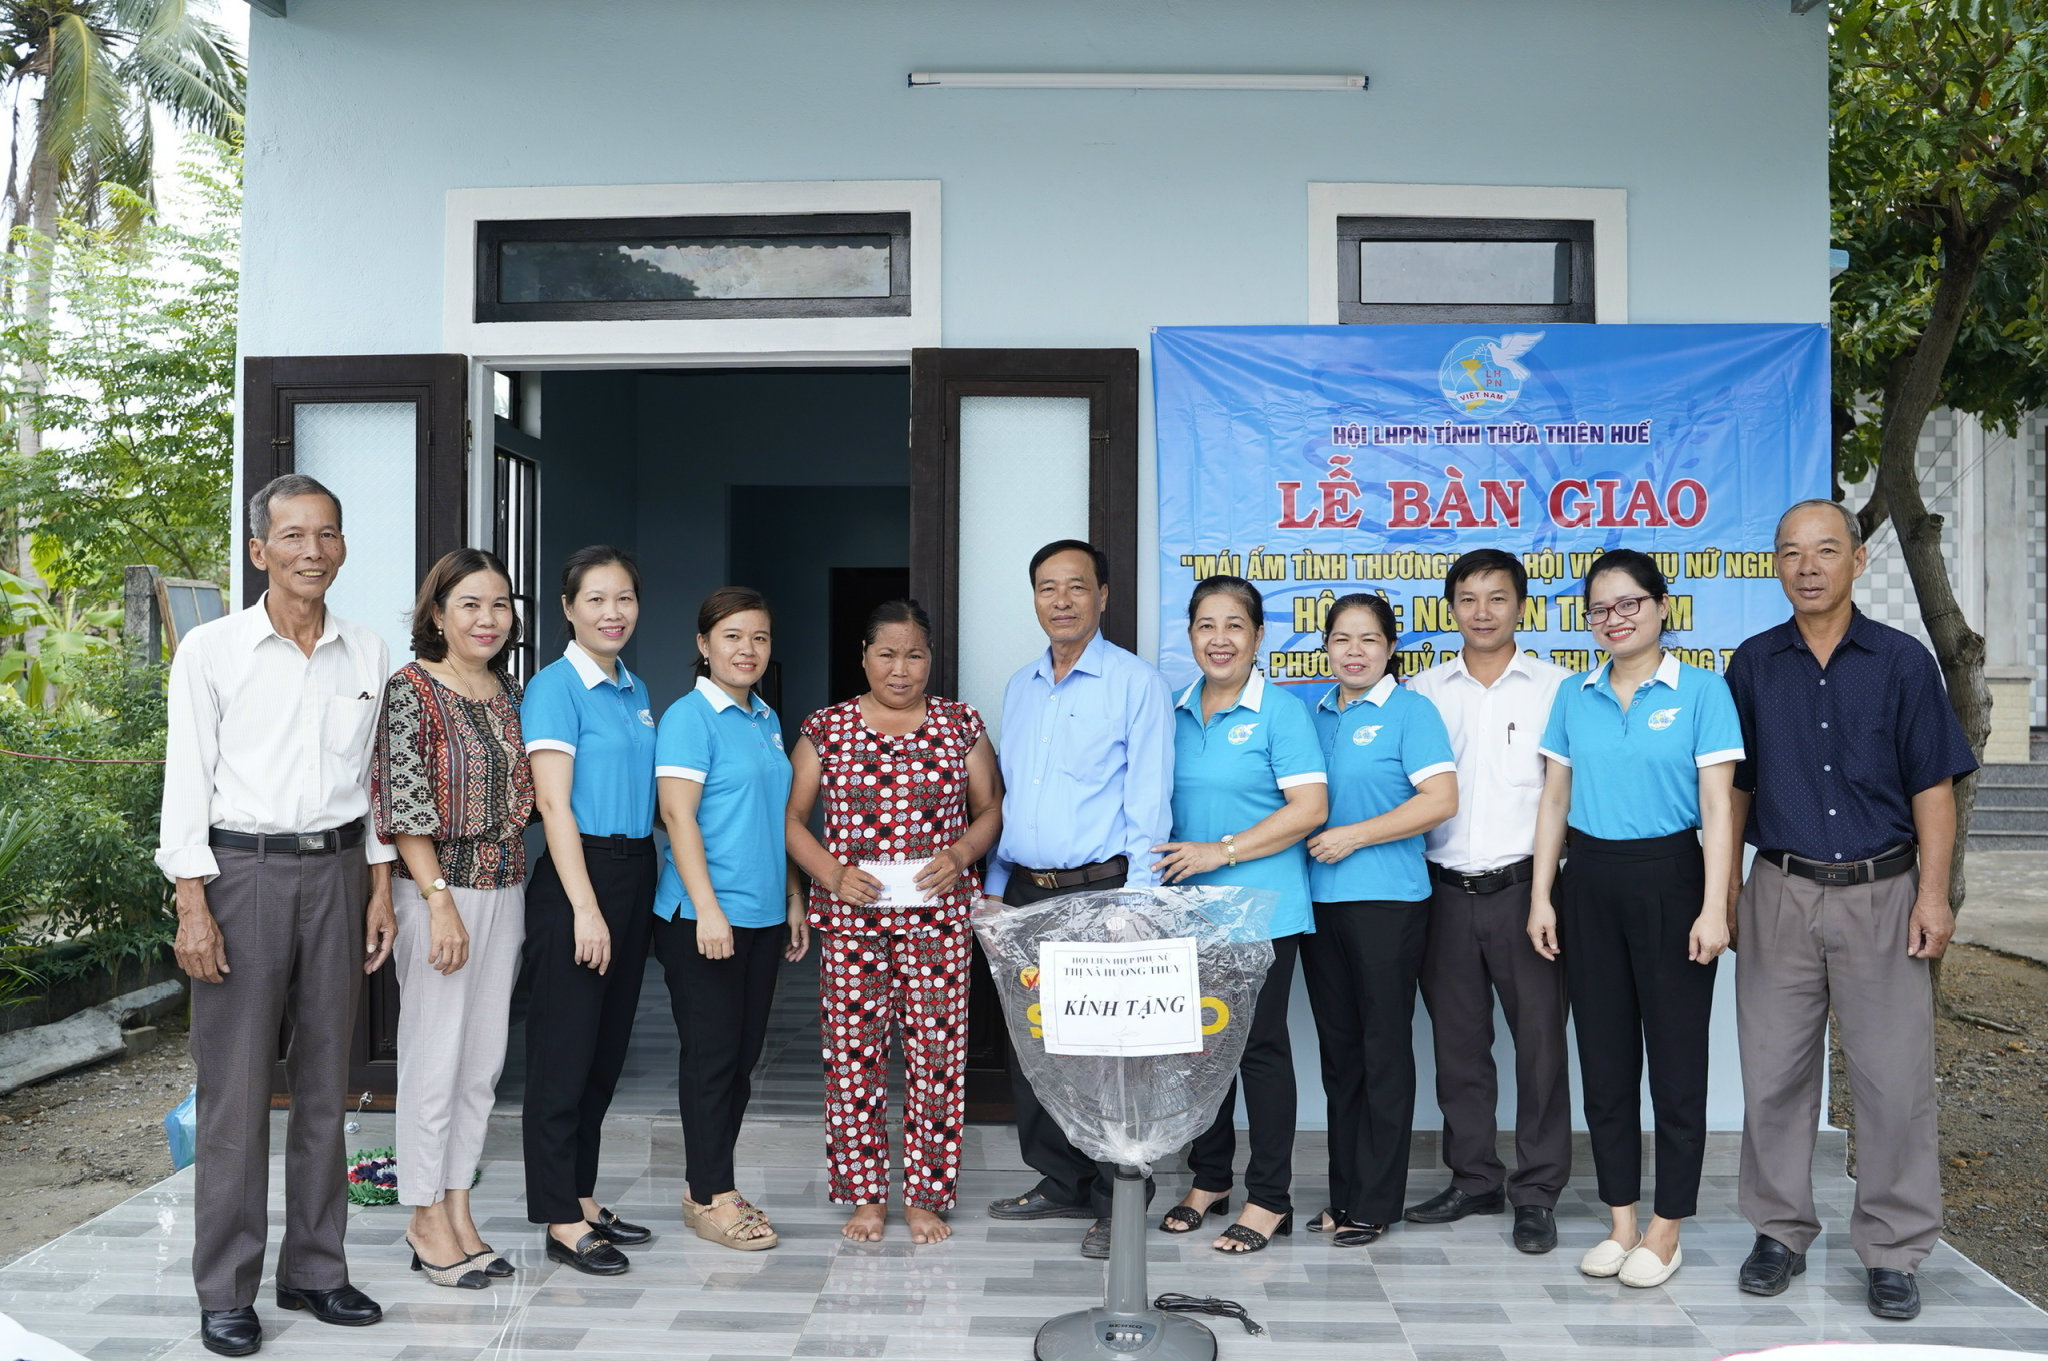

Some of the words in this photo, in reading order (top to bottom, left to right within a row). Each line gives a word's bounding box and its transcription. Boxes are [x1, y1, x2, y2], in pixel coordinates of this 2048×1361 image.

[1486, 370, 1502, 378] LH
[1486, 379, 1503, 388] PN
[1483, 392, 1503, 401] NAM
[1333, 423, 1368, 448] HỘI
[1373, 426, 1428, 444] LHPN
[1433, 420, 1481, 443] TỈNH
[1487, 422, 1540, 443] THỪA
[1545, 422, 1605, 443] THIÊN
[1610, 420, 1652, 443] HUẾ
[1277, 455, 1364, 528] LỄ
[1387, 466, 1525, 528] BÀN
[1549, 478, 1708, 528] GIAO
[1247, 546, 1285, 580] ẤM
[1292, 549, 1347, 580] TÌNH
[1523, 548, 1564, 584] HỘI
[1685, 547, 1721, 579] NỮ
[1064, 994, 1119, 1016] KÍNH
[1126, 995, 1185, 1020] TẶNG
